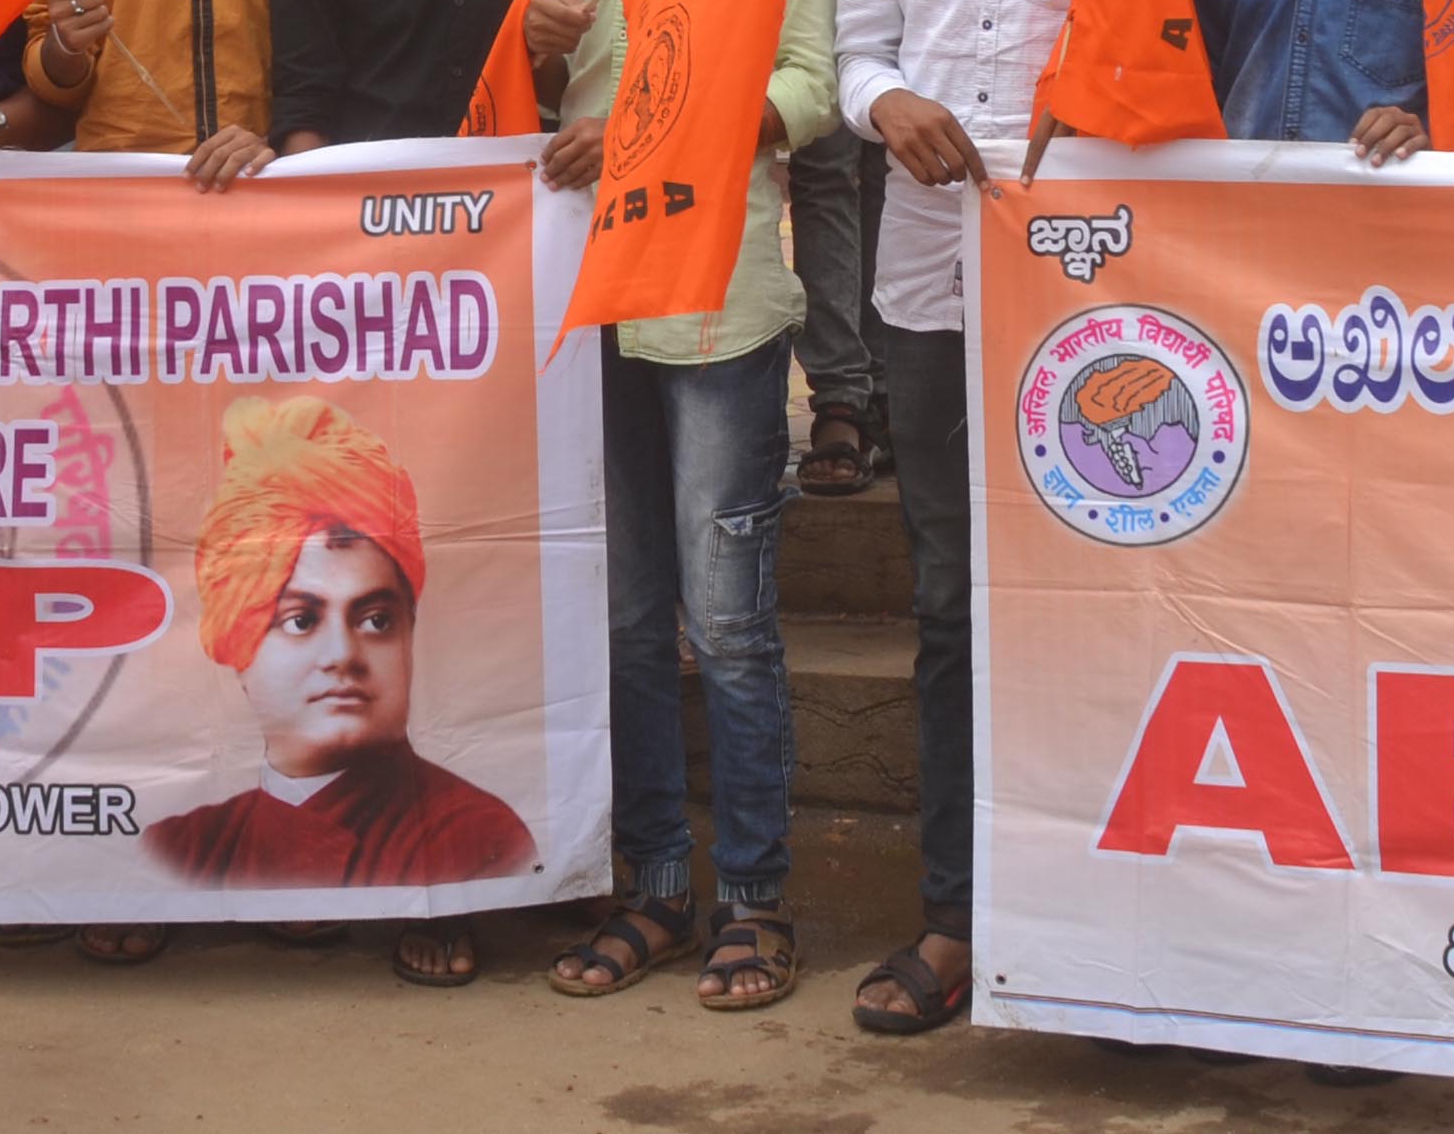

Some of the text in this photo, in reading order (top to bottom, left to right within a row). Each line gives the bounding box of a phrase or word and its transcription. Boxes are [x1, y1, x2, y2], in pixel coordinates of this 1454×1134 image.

[360, 190, 493, 237] UNITY
[1027, 204, 1133, 283] ಜ್ಞಾನ
[165, 279, 490, 376] PARISHAD
[1048, 318, 1124, 364] भारतीय
[1136, 313, 1213, 370] विद्यार्थी
[1104, 503, 1156, 534] शील
